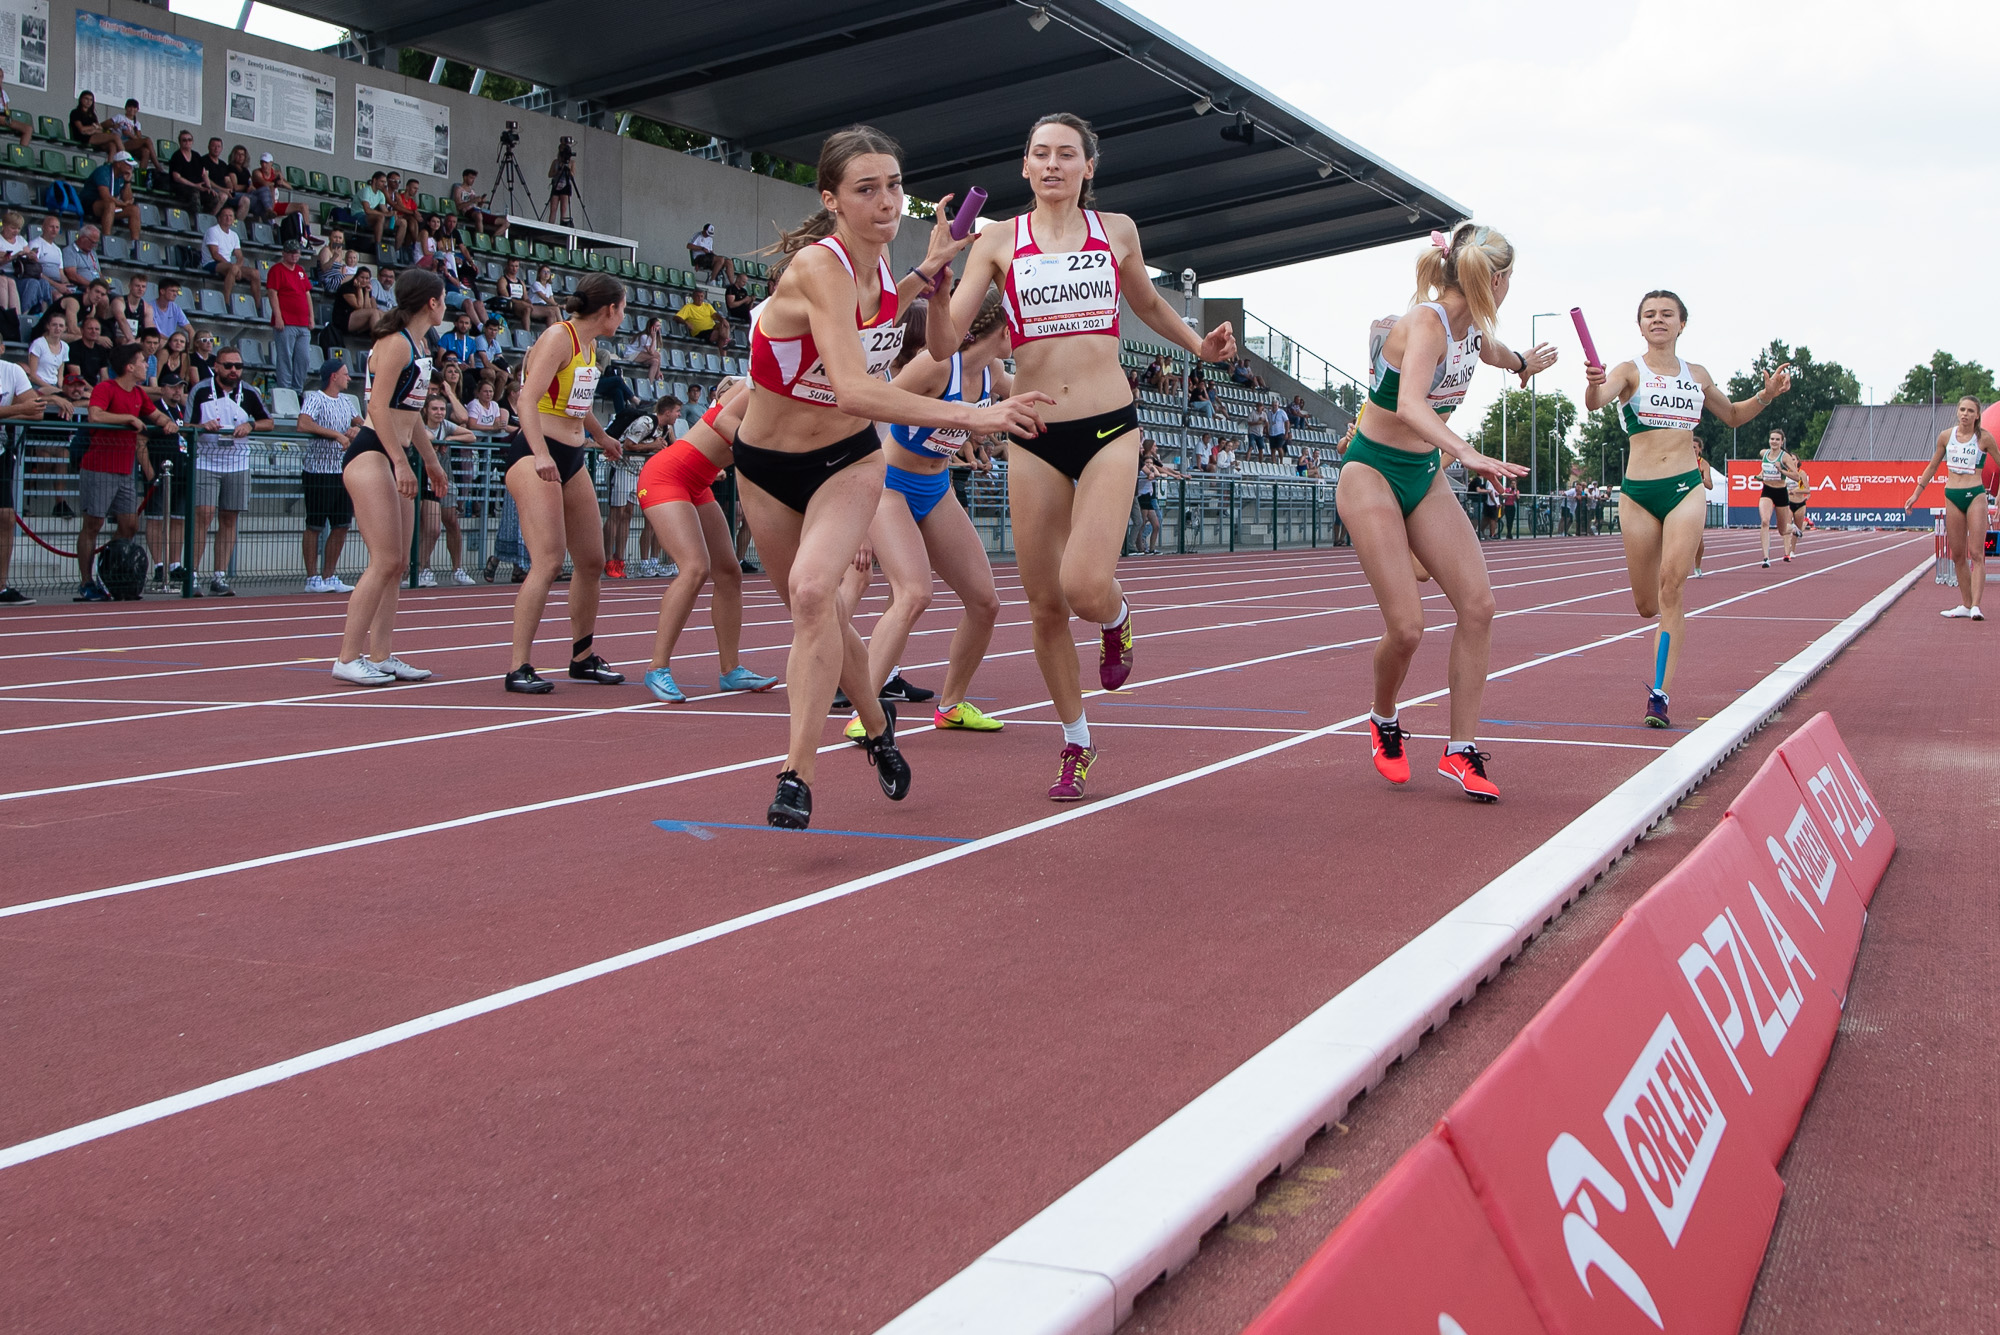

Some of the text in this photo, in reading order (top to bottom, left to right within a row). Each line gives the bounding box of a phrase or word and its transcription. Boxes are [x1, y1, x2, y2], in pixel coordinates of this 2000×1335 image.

[1067, 253, 1107, 271] 229
[1020, 280, 1113, 306] KOCZANOWA
[1037, 318, 1105, 334] SUWAŁKI 2021
[870, 329, 903, 352] 228
[1465, 334, 1482, 356] 160
[808, 390, 837, 403] SUWA
[1650, 394, 1694, 410] GAJDA
[1648, 419, 1678, 427] SUWAŁKI
[1840, 483, 1861, 491] U23
[1841, 475, 1949, 483] MISTRZOSTWA PLS
[1825, 512, 1852, 522] 24-25
[1854, 512, 1882, 522] LIPCA
[1884, 512, 1906, 522] 2021
[1807, 752, 1880, 861] PZLA
[1793, 816, 1830, 889] ORLEN
[1677, 880, 1816, 1095] PZLA
[1623, 1036, 1713, 1209] ORLEN
